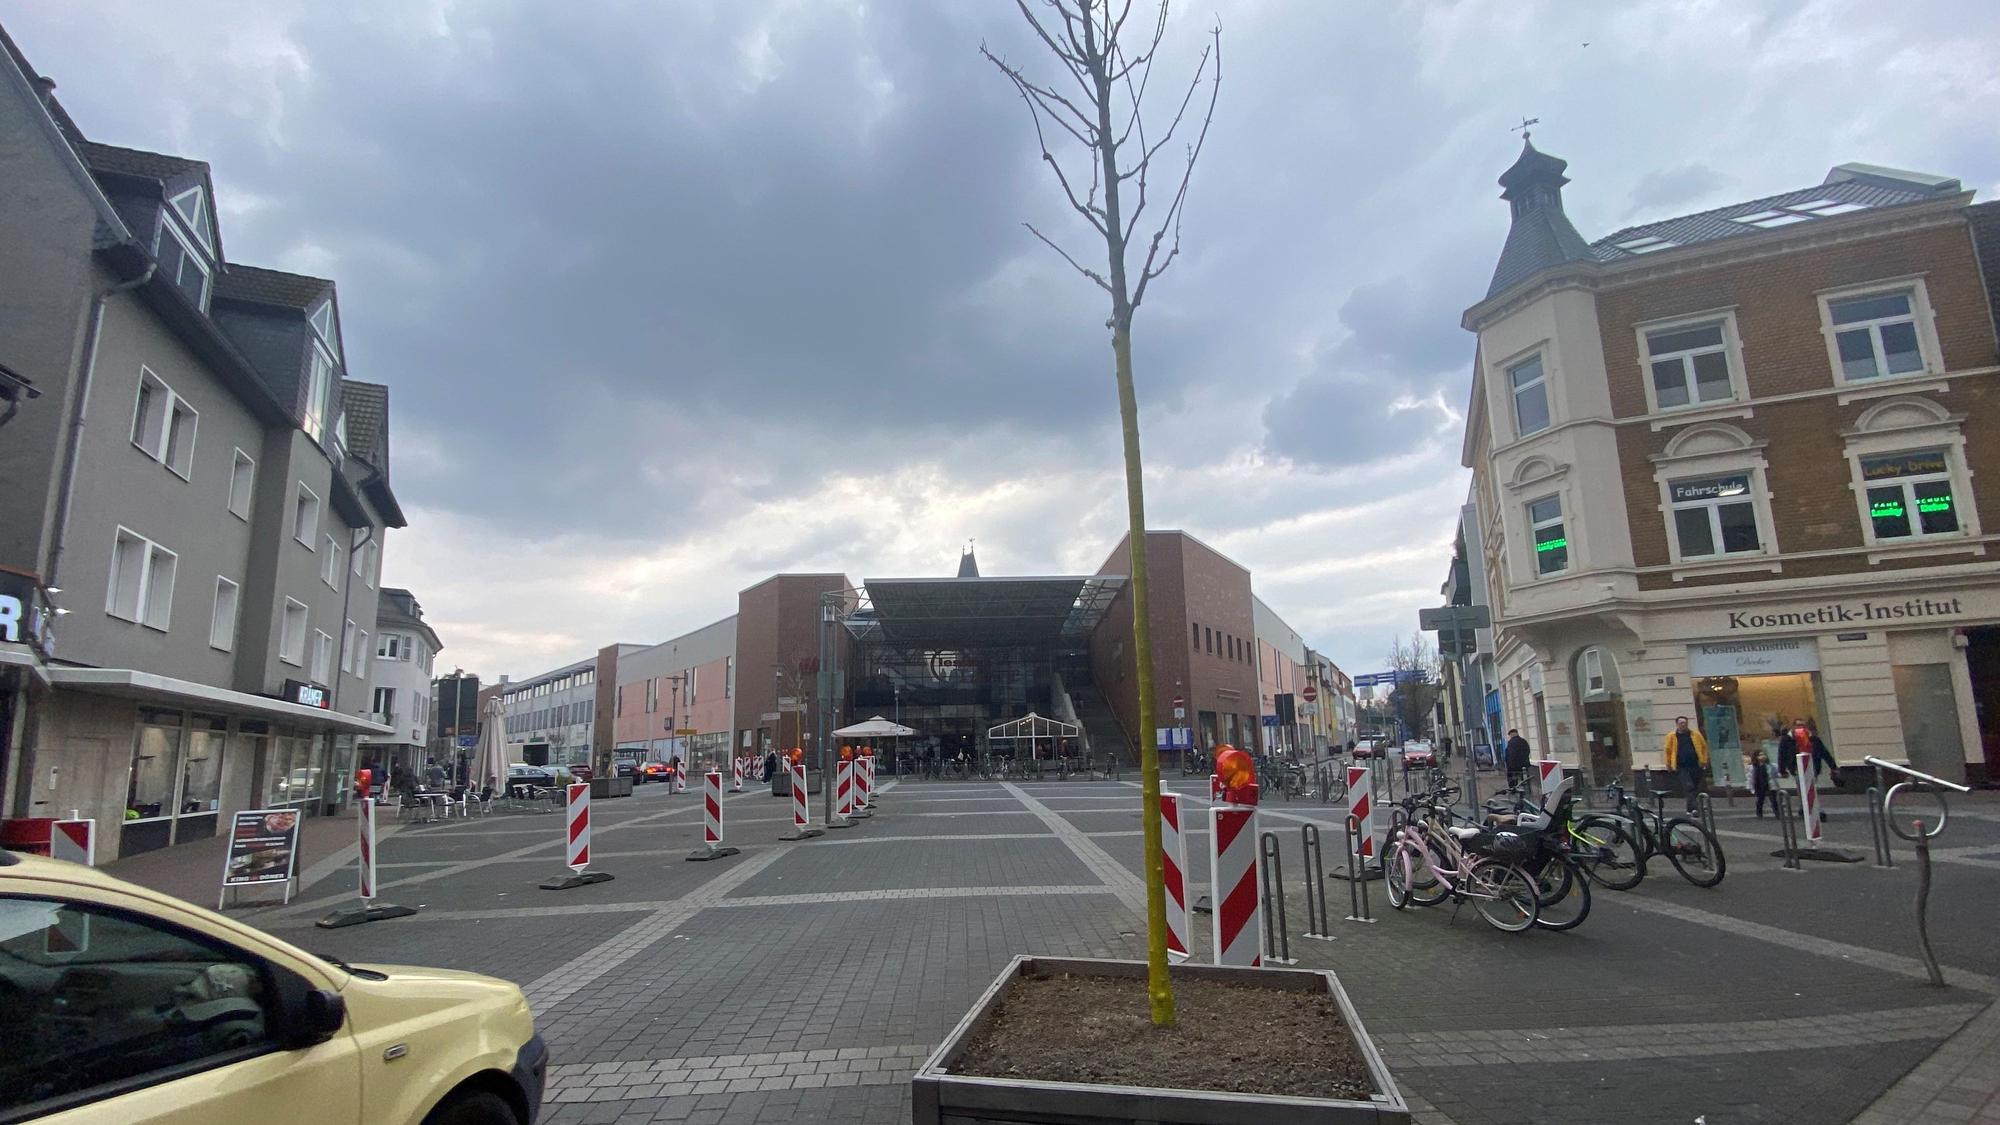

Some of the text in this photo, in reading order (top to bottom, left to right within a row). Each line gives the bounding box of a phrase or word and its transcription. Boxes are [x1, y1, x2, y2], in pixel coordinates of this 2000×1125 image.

[1676, 481, 1744, 498] Fahrschule
[1874, 495, 1951, 509] FAHR SCHULE
[1729, 598, 1963, 629] Kosmetik-Institut
